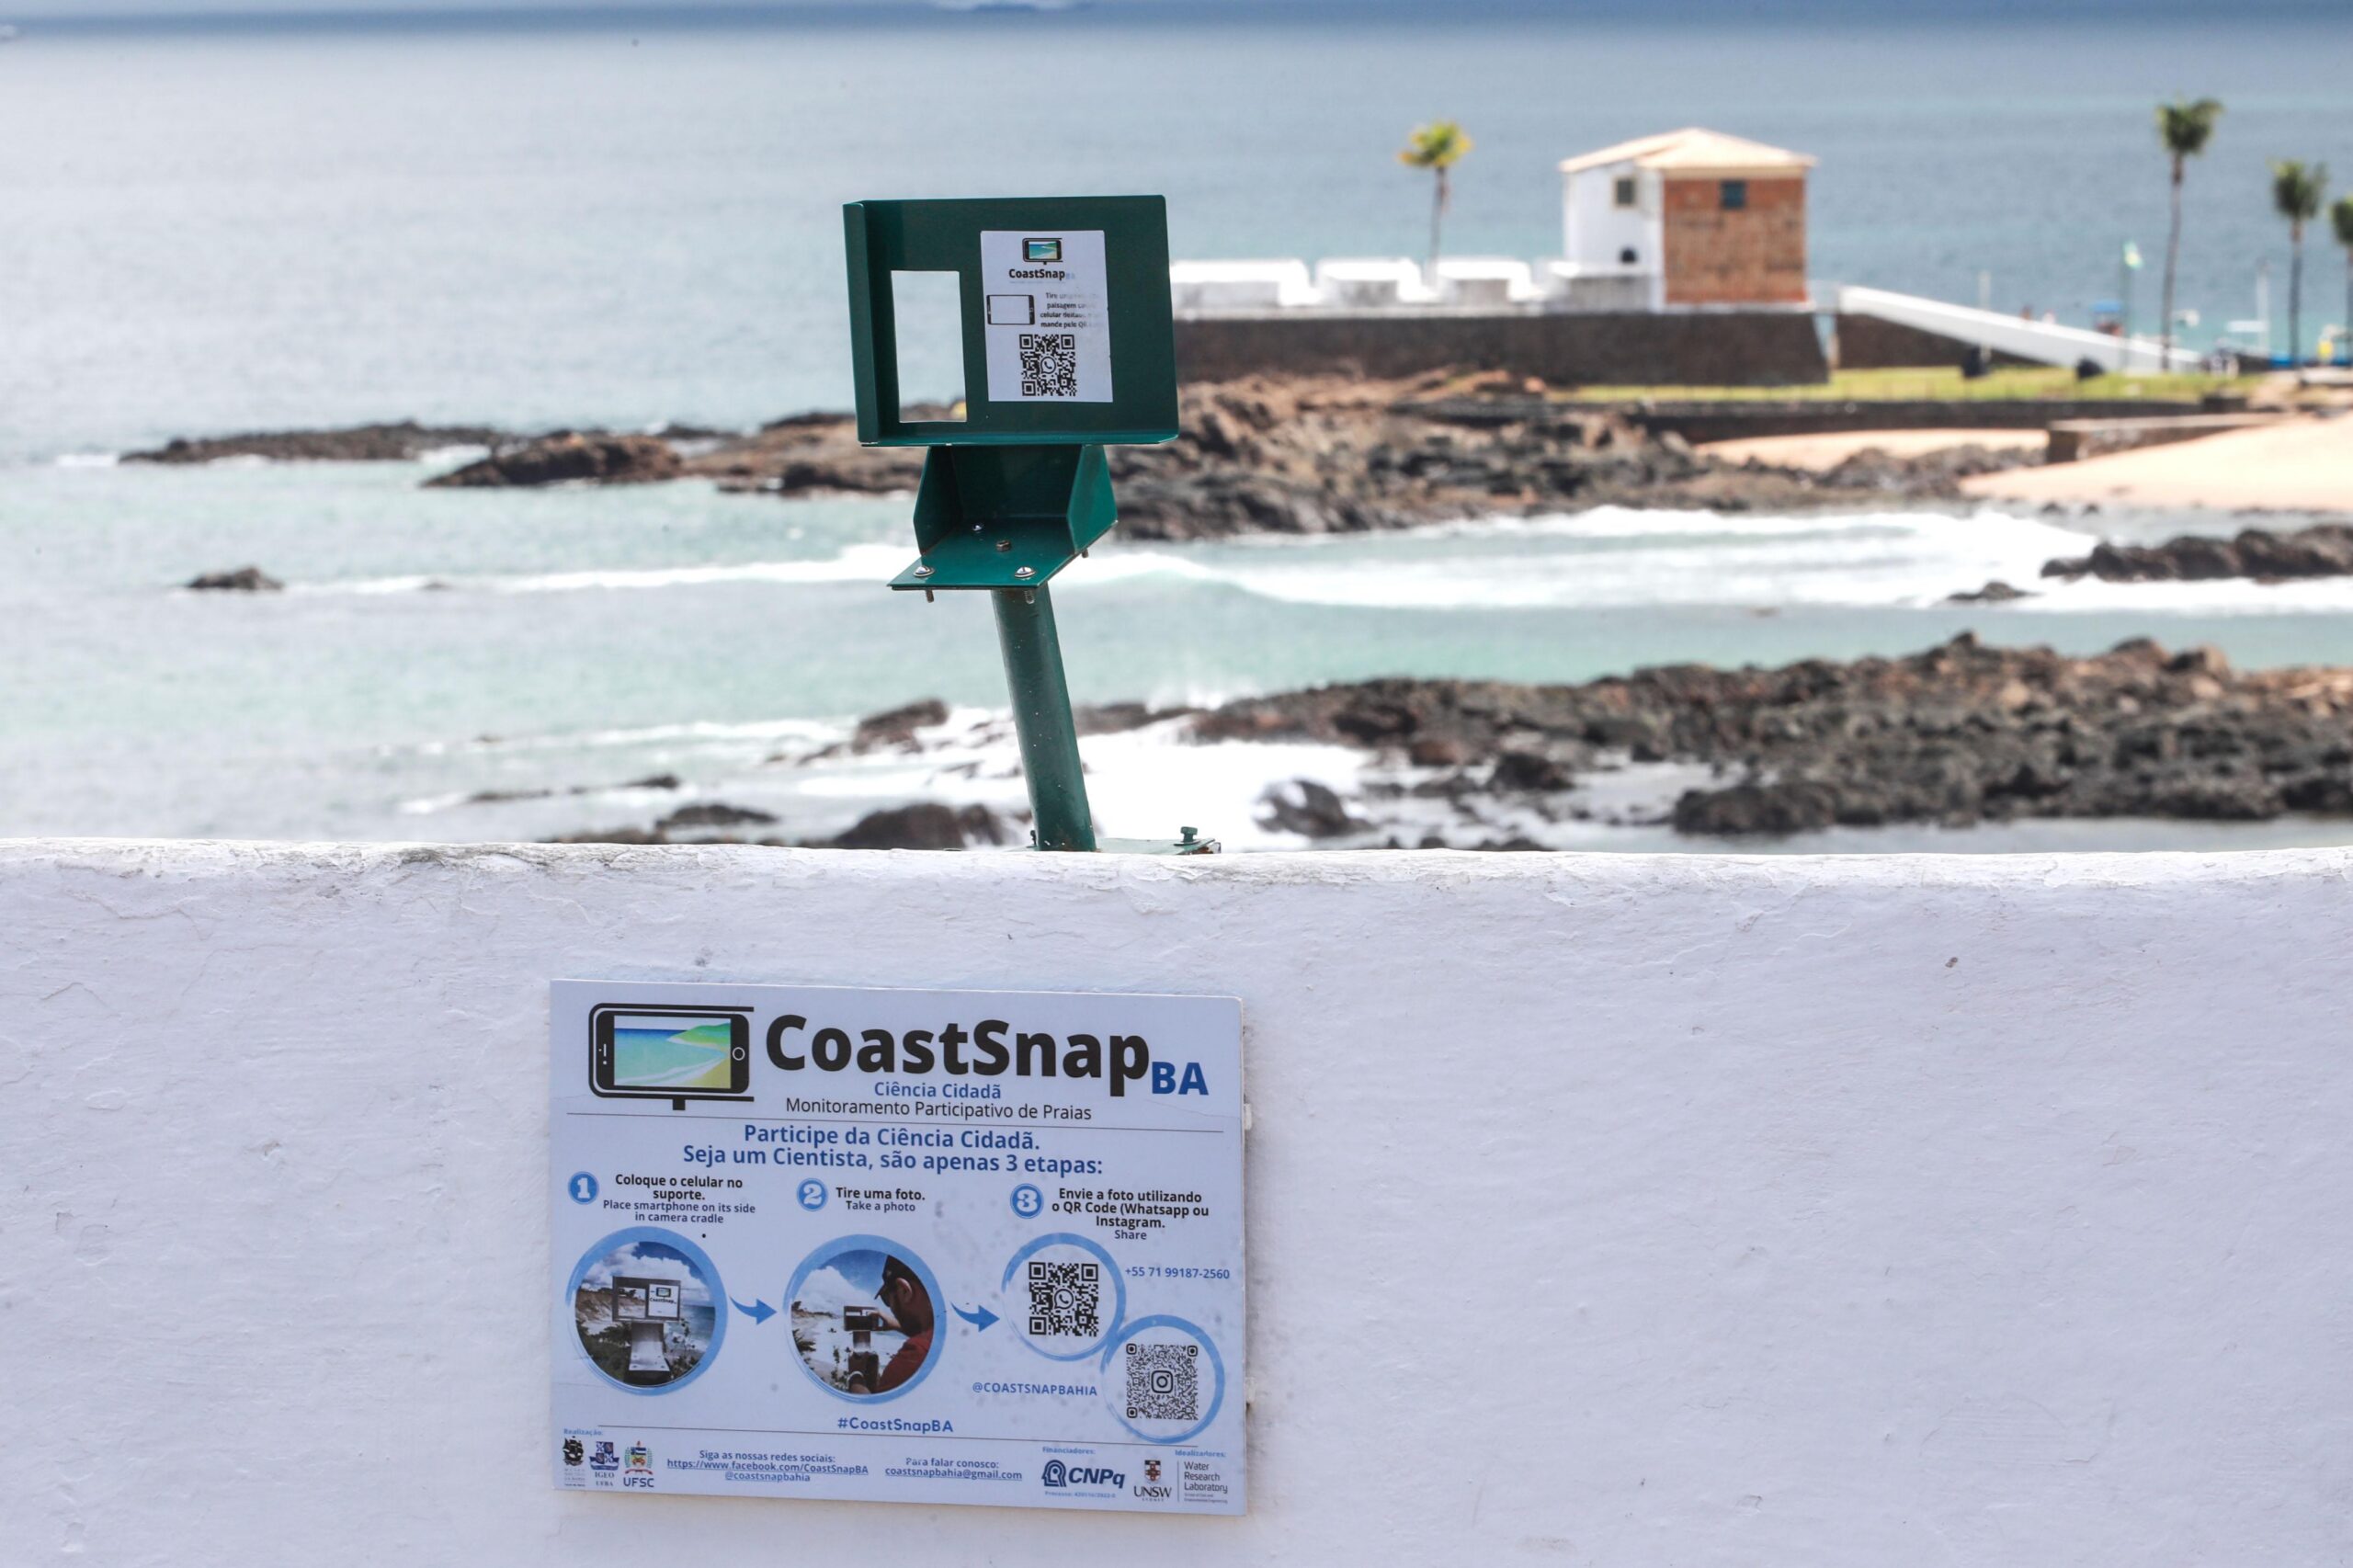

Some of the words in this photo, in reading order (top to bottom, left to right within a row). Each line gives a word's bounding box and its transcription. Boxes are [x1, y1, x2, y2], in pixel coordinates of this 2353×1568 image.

[1009, 268, 1065, 280] CoastSnap
[766, 1014, 1149, 1097] CoastSnap
[1151, 1061, 1210, 1096] BA
[874, 1081, 937, 1098] Ciência
[942, 1083, 1002, 1099] Cidadã
[786, 1097, 910, 1116] Monitoramento
[915, 1102, 1014, 1120] Participativo
[1018, 1103, 1038, 1119] de
[1043, 1105, 1092, 1120] Praias
[745, 1124, 838, 1149] Participe
[845, 1126, 870, 1145] da
[877, 1128, 954, 1148] Ciência
[961, 1131, 1040, 1151] Cidadã.
[683, 1145, 726, 1168] Seja
[733, 1149, 767, 1165] um
[774, 1148, 874, 1170] Cientista,
[881, 1151, 916, 1169] são
[923, 1154, 1000, 1175] apenas
[1006, 1154, 1018, 1173] 3
[1024, 1157, 1103, 1178] etapas:
[576, 1176, 591, 1199] 1
[615, 1174, 666, 1188] Coloque
[670, 1177, 677, 1187] o
[680, 1176, 724, 1187] celular
[727, 1178, 744, 1188] no
[653, 1188, 706, 1202] suporte.
[802, 1183, 823, 1206] 2
[835, 1187, 861, 1199] Tire
[864, 1189, 892, 1200] uma
[895, 1187, 926, 1201] foto.
[1017, 1188, 1038, 1212] 3
[1059, 1187, 1094, 1200] Envie
[1097, 1191, 1104, 1200] a
[1108, 1188, 1134, 1201] foto
[1137, 1189, 1203, 1203] utilizando
[603, 1199, 631, 1210] Place
[633, 1201, 699, 1213] smartphone
[701, 1203, 715, 1212] on
[718, 1201, 732, 1213] its
[733, 1201, 756, 1213] side
[846, 1200, 872, 1210] Take
[874, 1202, 881, 1211] a
[883, 1200, 916, 1214] photo
[1051, 1202, 1060, 1212] o
[1063, 1201, 1083, 1215] QR
[1085, 1201, 1118, 1214] Code
[1120, 1202, 1190, 1219] (Whatsapp
[1193, 1207, 1210, 1217] ou
[635, 1211, 645, 1221] in
[648, 1213, 688, 1223] camera
[690, 1212, 724, 1223] cradle
[1096, 1215, 1165, 1231] Instagram.
[1114, 1230, 1148, 1240] Share
[1125, 1267, 1146, 1278] +55
[1148, 1267, 1162, 1278] 71
[1165, 1267, 1231, 1279] 99187-2560
[972, 1381, 1097, 1397] @COASTSNAPBAHIA
[837, 1416, 954, 1434] #CoastSnapBA
[699, 1449, 720, 1461] Siga
[722, 1452, 733, 1460] as
[735, 1452, 768, 1461] nossas
[770, 1451, 798, 1462] redes
[800, 1453, 836, 1463] sociais:
[666, 1458, 870, 1475] https://www.facebook.com/CoastSnapBA
[931, 1457, 954, 1468] falar
[956, 1460, 1000, 1470] conosco:
[1183, 1460, 1210, 1471] Water
[724, 1471, 811, 1483] @coastsnapbahia
[885, 1467, 1023, 1482] coastsnapbahia@gmail.com
[1068, 1467, 1126, 1489] CNPq
[1184, 1471, 1221, 1482] Research
[622, 1477, 655, 1488] UFSC
[1184, 1482, 1229, 1494] Laboratory
[1133, 1485, 1173, 1498] UNSW
